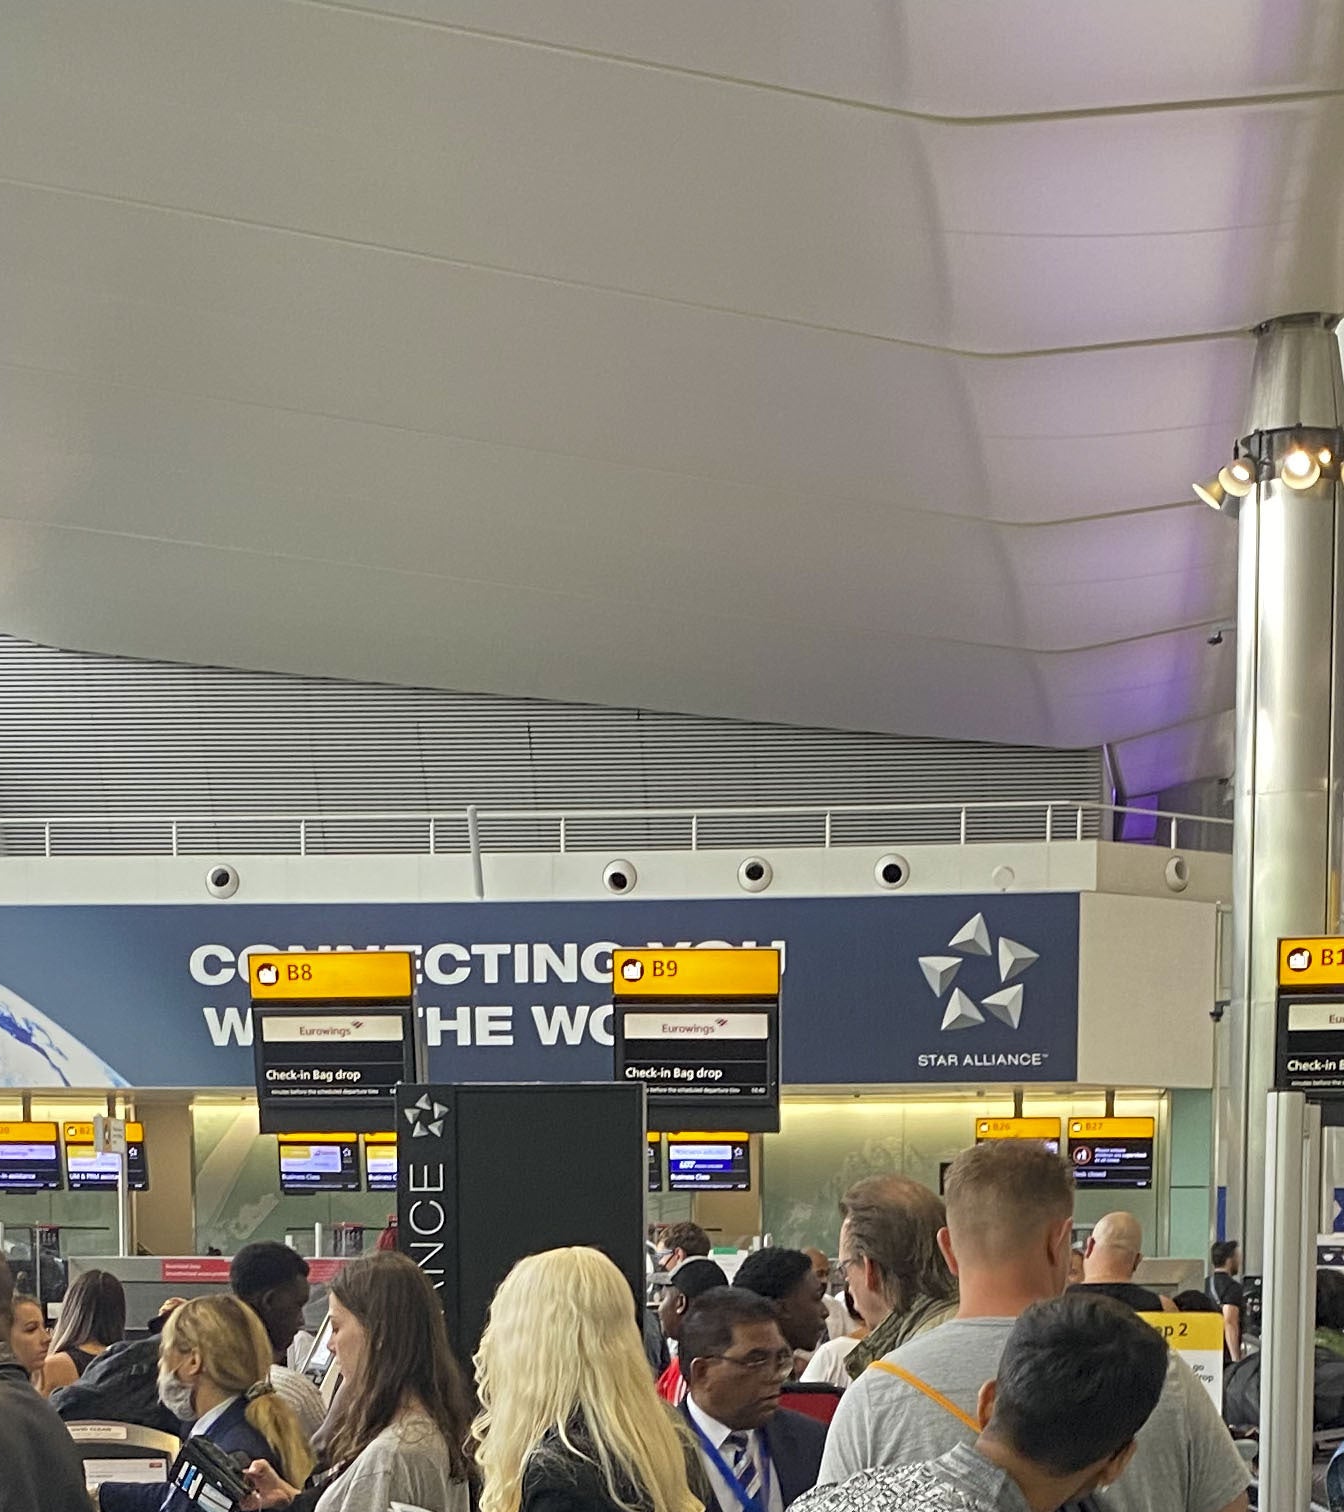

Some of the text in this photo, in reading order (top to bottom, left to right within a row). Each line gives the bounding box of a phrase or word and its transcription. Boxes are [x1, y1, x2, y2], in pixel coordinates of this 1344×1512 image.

[288, 964, 313, 982] B8
[652, 960, 678, 978] B9
[299, 1026, 352, 1037] Eurowings
[662, 1023, 716, 1036] Eurowings
[918, 1054, 958, 1067] STAR
[1287, 1059, 1337, 1072] Check-in
[265, 1069, 362, 1083] Check-in Bag drop
[625, 1066, 723, 1081] Check-in Bag drop
[1085, 1123, 1104, 1131] B27
[1178, 1322, 1189, 1337] 2
